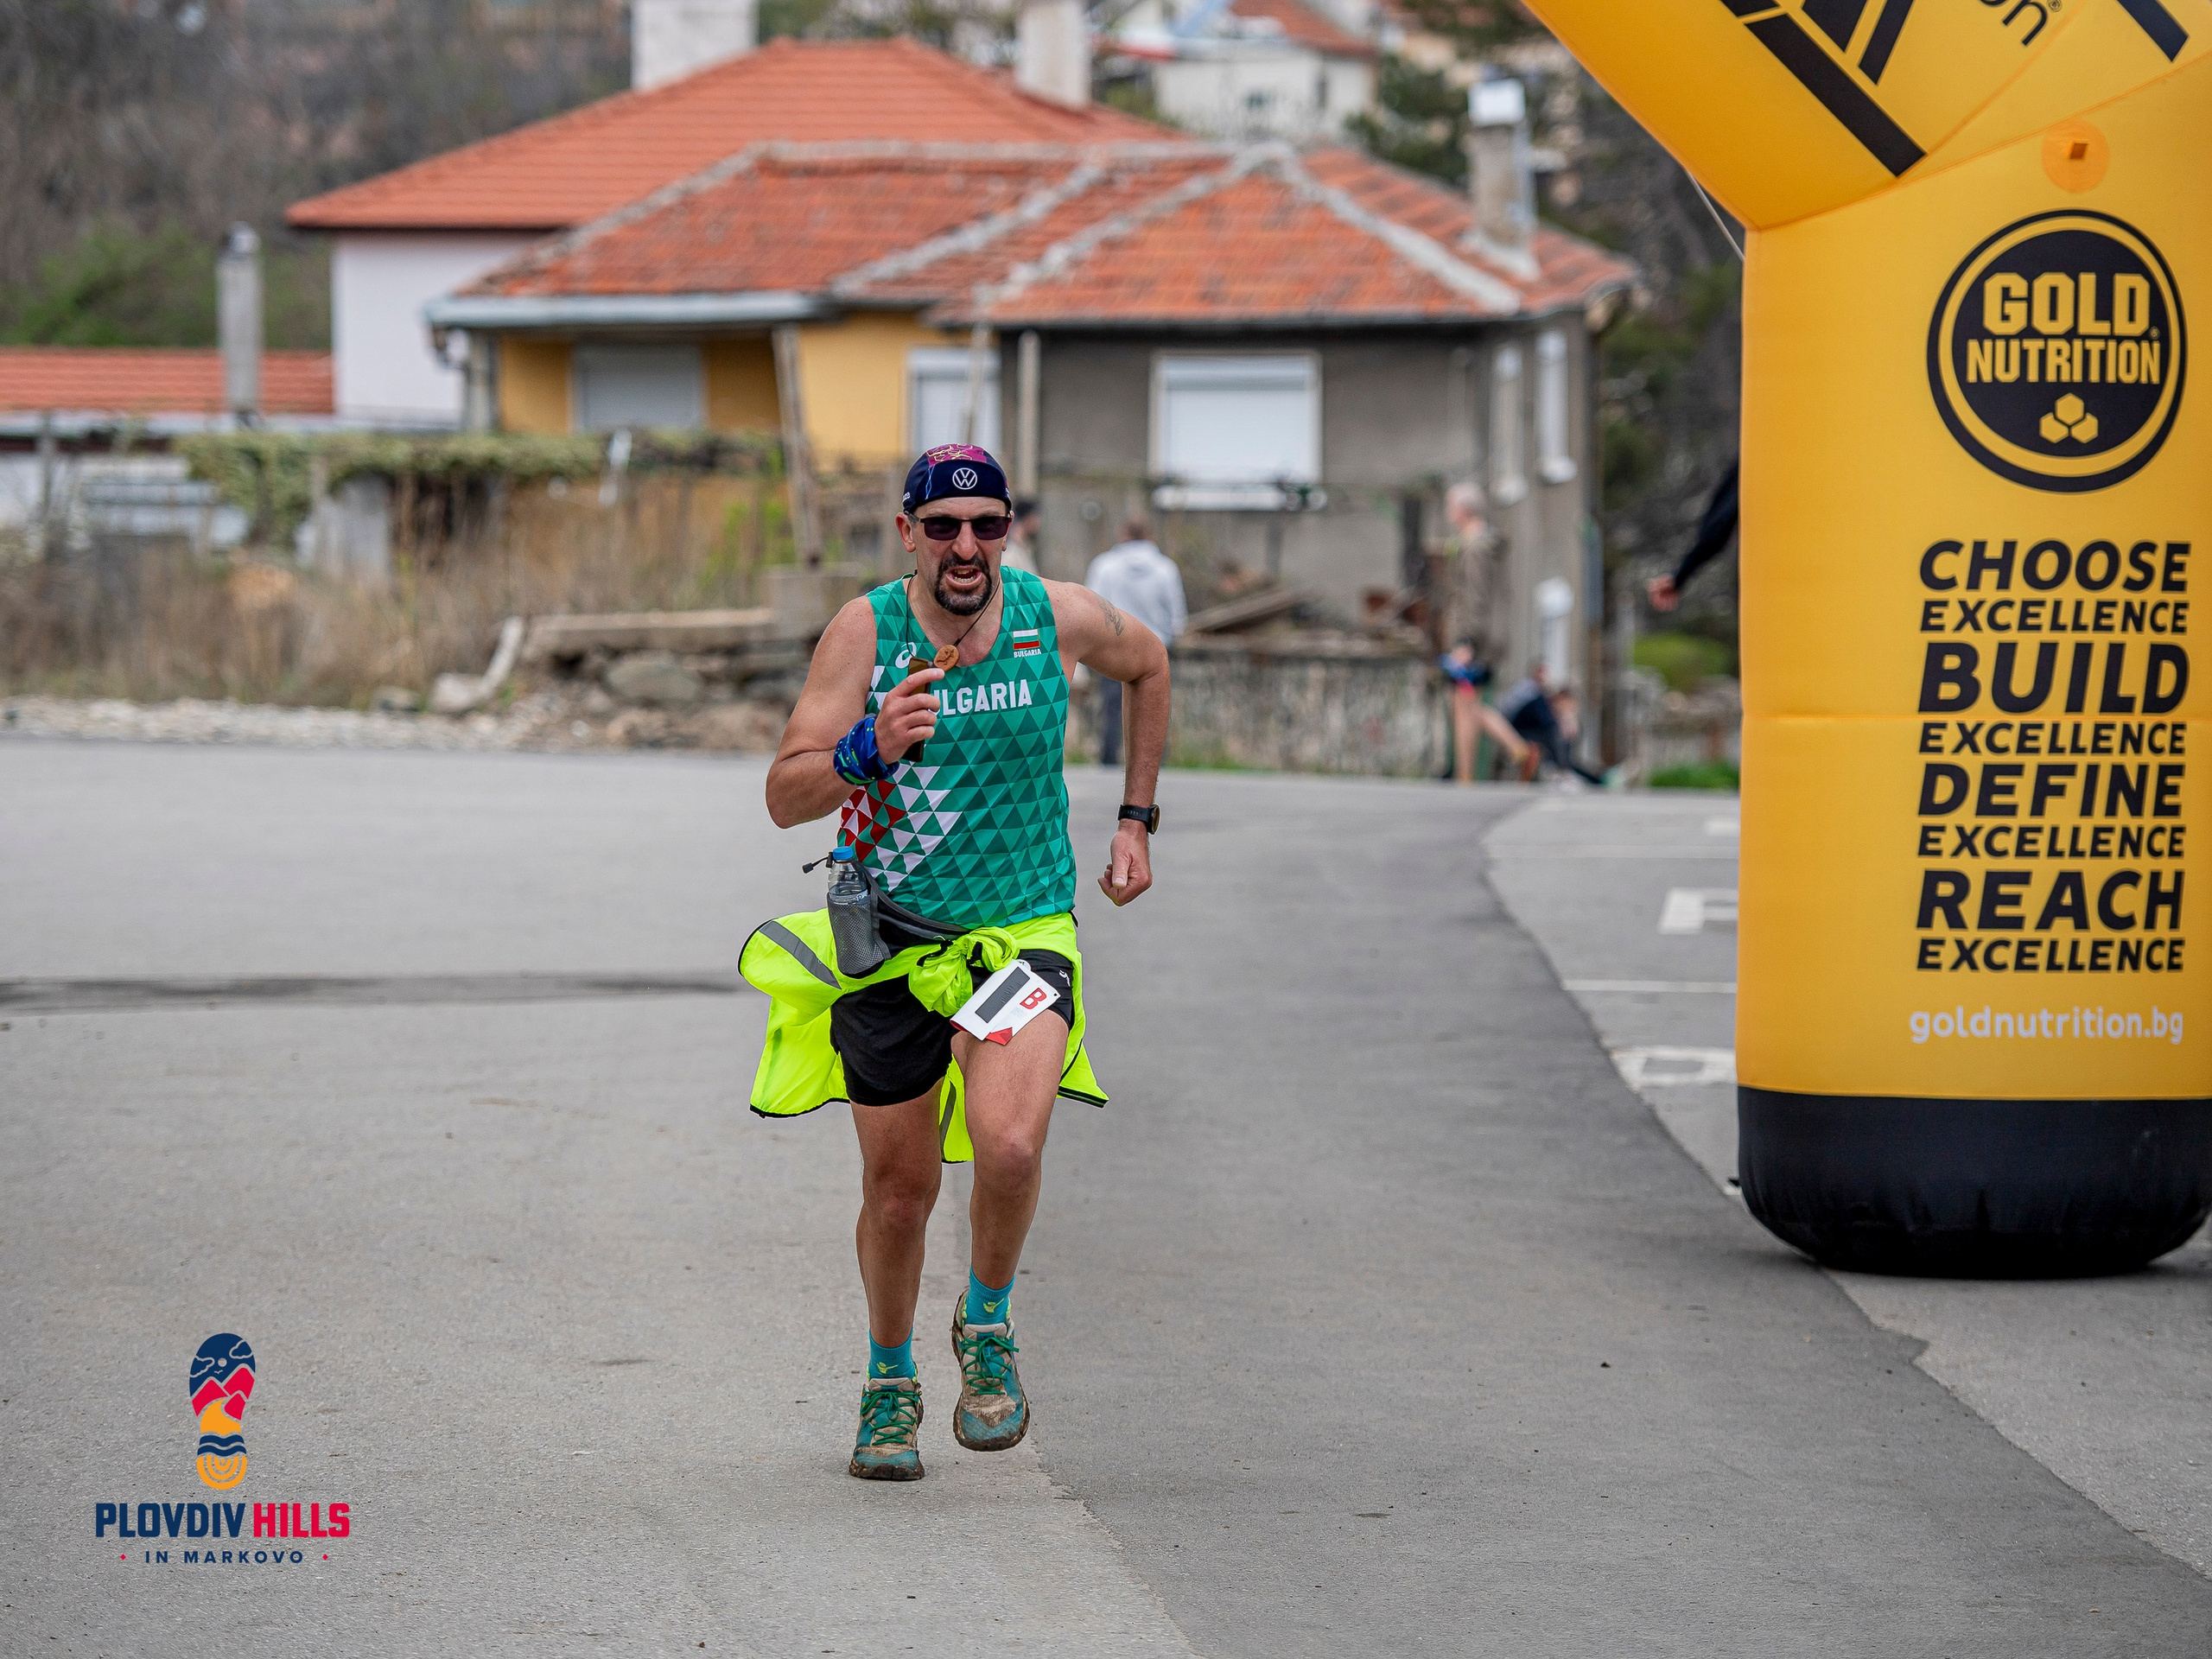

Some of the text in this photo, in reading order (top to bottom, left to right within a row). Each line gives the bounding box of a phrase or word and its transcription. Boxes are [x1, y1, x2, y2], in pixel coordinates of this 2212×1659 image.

[1982, 271, 2151, 337] GOLD
[1967, 339, 2160, 385] NUTRITION
[1919, 539, 2191, 593] CHOOSE
[1920, 600, 2190, 634] EXCELLENCE
[1014, 649, 1041, 658] BULGARIA
[1917, 641, 2190, 715] BUILD
[1918, 721, 2188, 755] EXCELLENCE
[1917, 762, 2187, 818] DEFINE
[1917, 825, 2187, 859] EXCELLENCE
[1916, 869, 2185, 931] REACH
[1916, 938, 2186, 973] EXCELLENCE
[1019, 988, 1047, 1010] B
[1909, 1005, 2184, 1045] goldnutrition.bg
